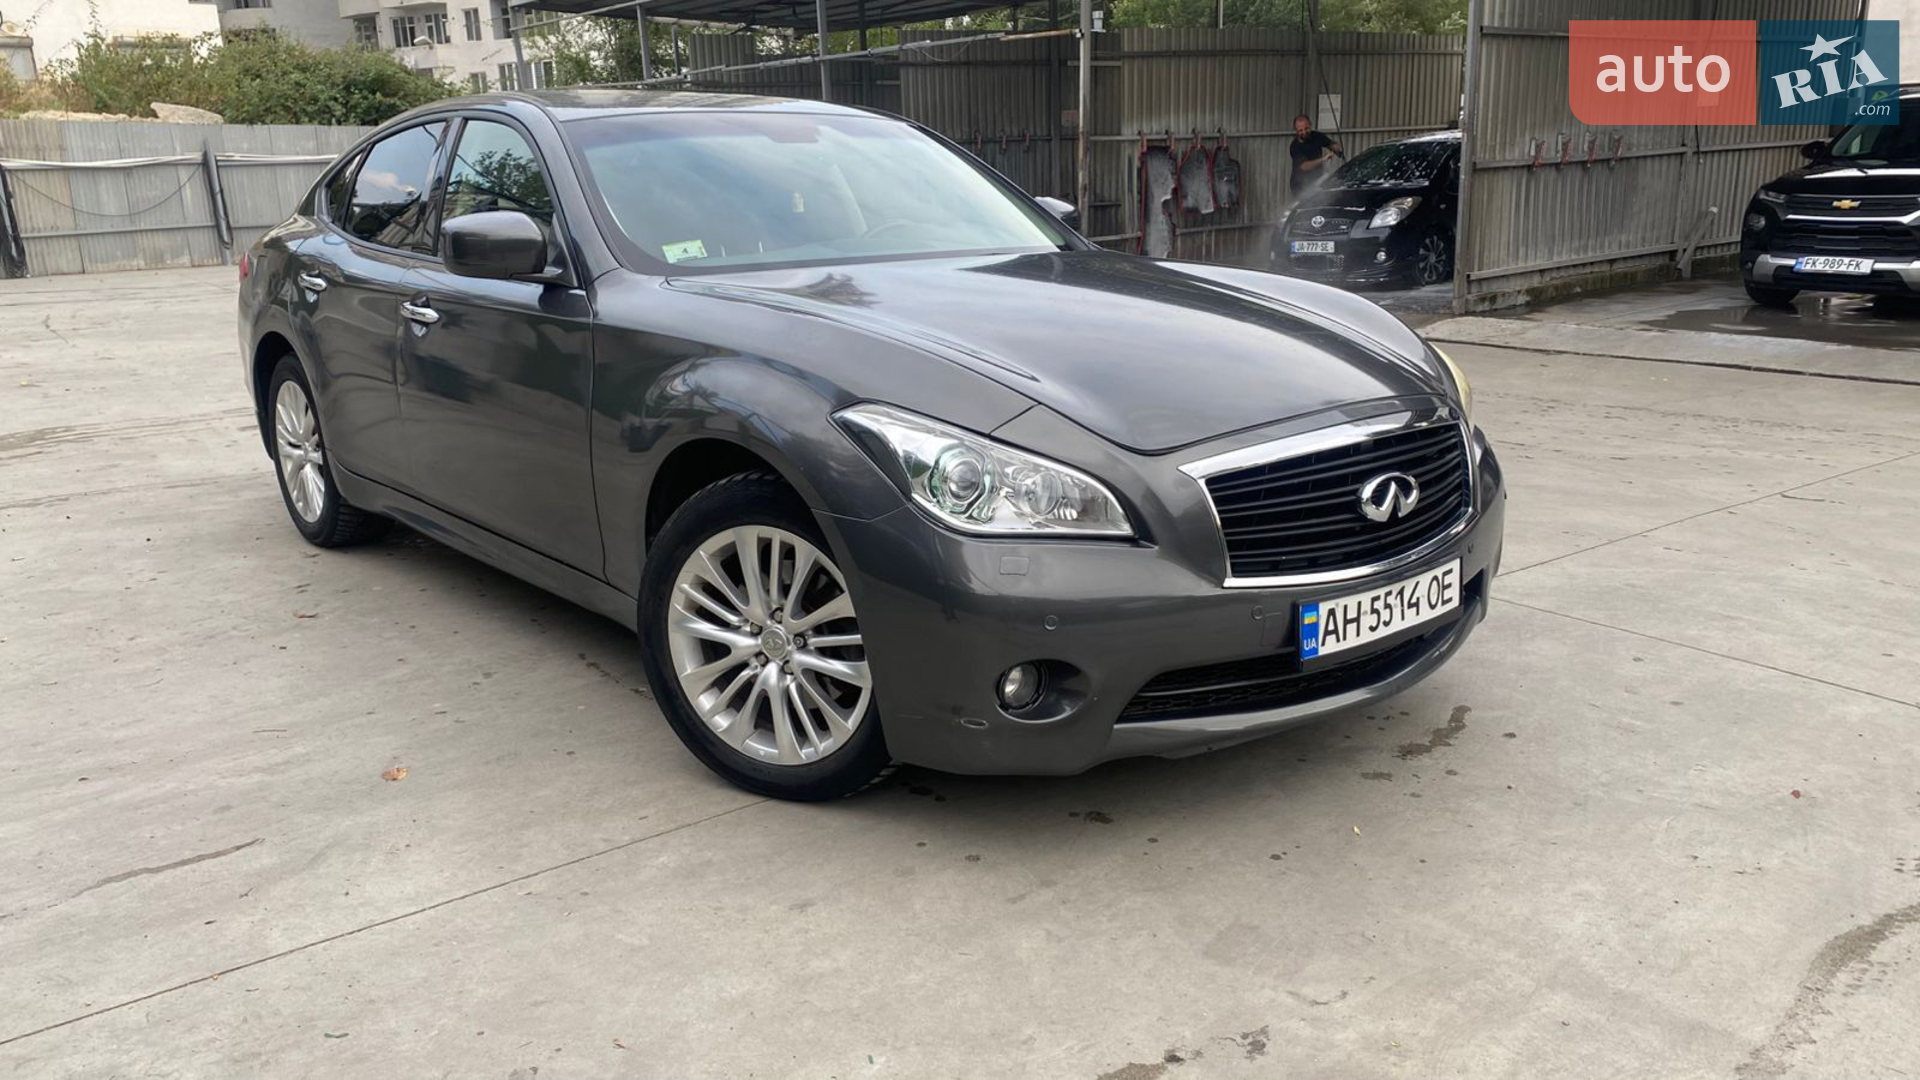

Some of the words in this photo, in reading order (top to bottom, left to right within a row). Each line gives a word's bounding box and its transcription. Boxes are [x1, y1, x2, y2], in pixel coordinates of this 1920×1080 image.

[1803, 257, 1864, 271] FK-989-FK
[1320, 601, 1362, 647] AH
[1368, 580, 1420, 633] 5514
[1427, 567, 1454, 611] OE
[1303, 637, 1318, 650] UA
